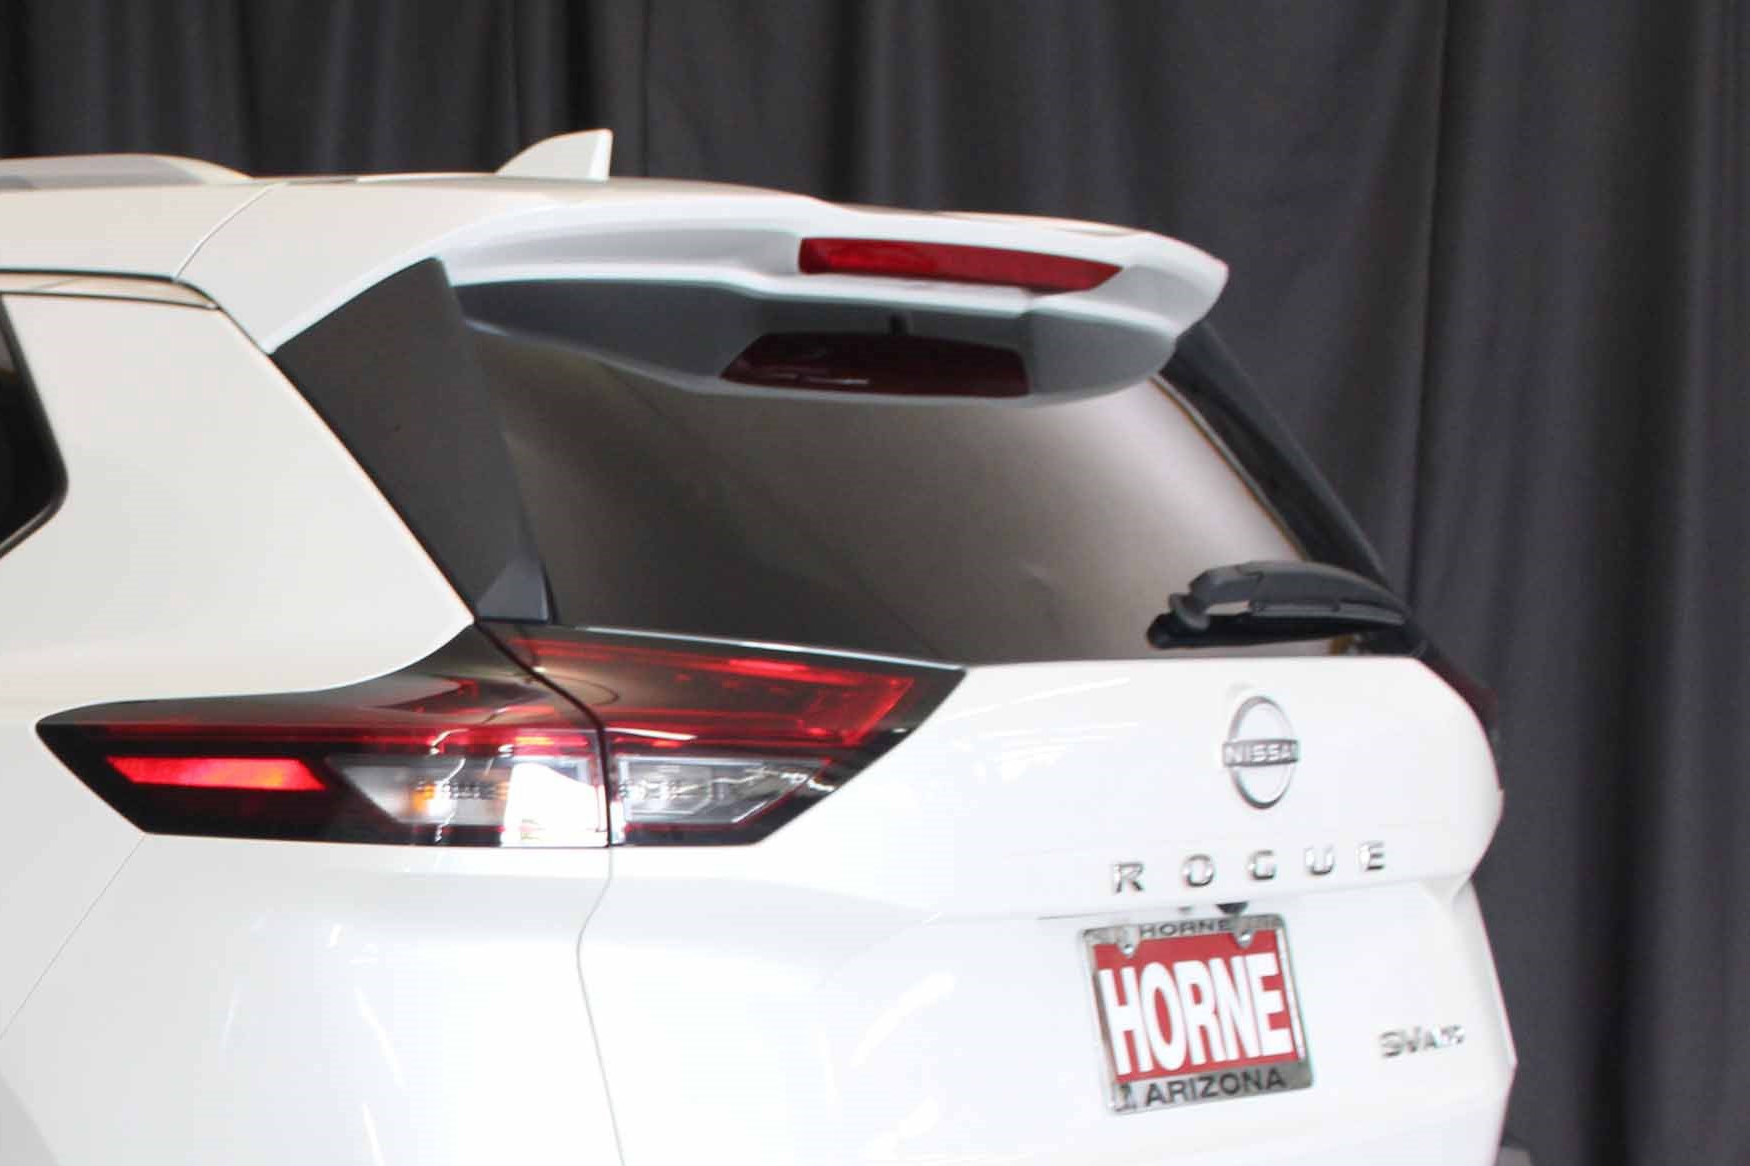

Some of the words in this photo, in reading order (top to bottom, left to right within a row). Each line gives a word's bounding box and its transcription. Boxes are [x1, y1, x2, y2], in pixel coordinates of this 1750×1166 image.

[1112, 841, 1386, 894] ROGUE
[1138, 918, 1230, 938] HORNE
[1098, 952, 1295, 1076] HORNE
[1145, 1067, 1288, 1107] ARIZONA
